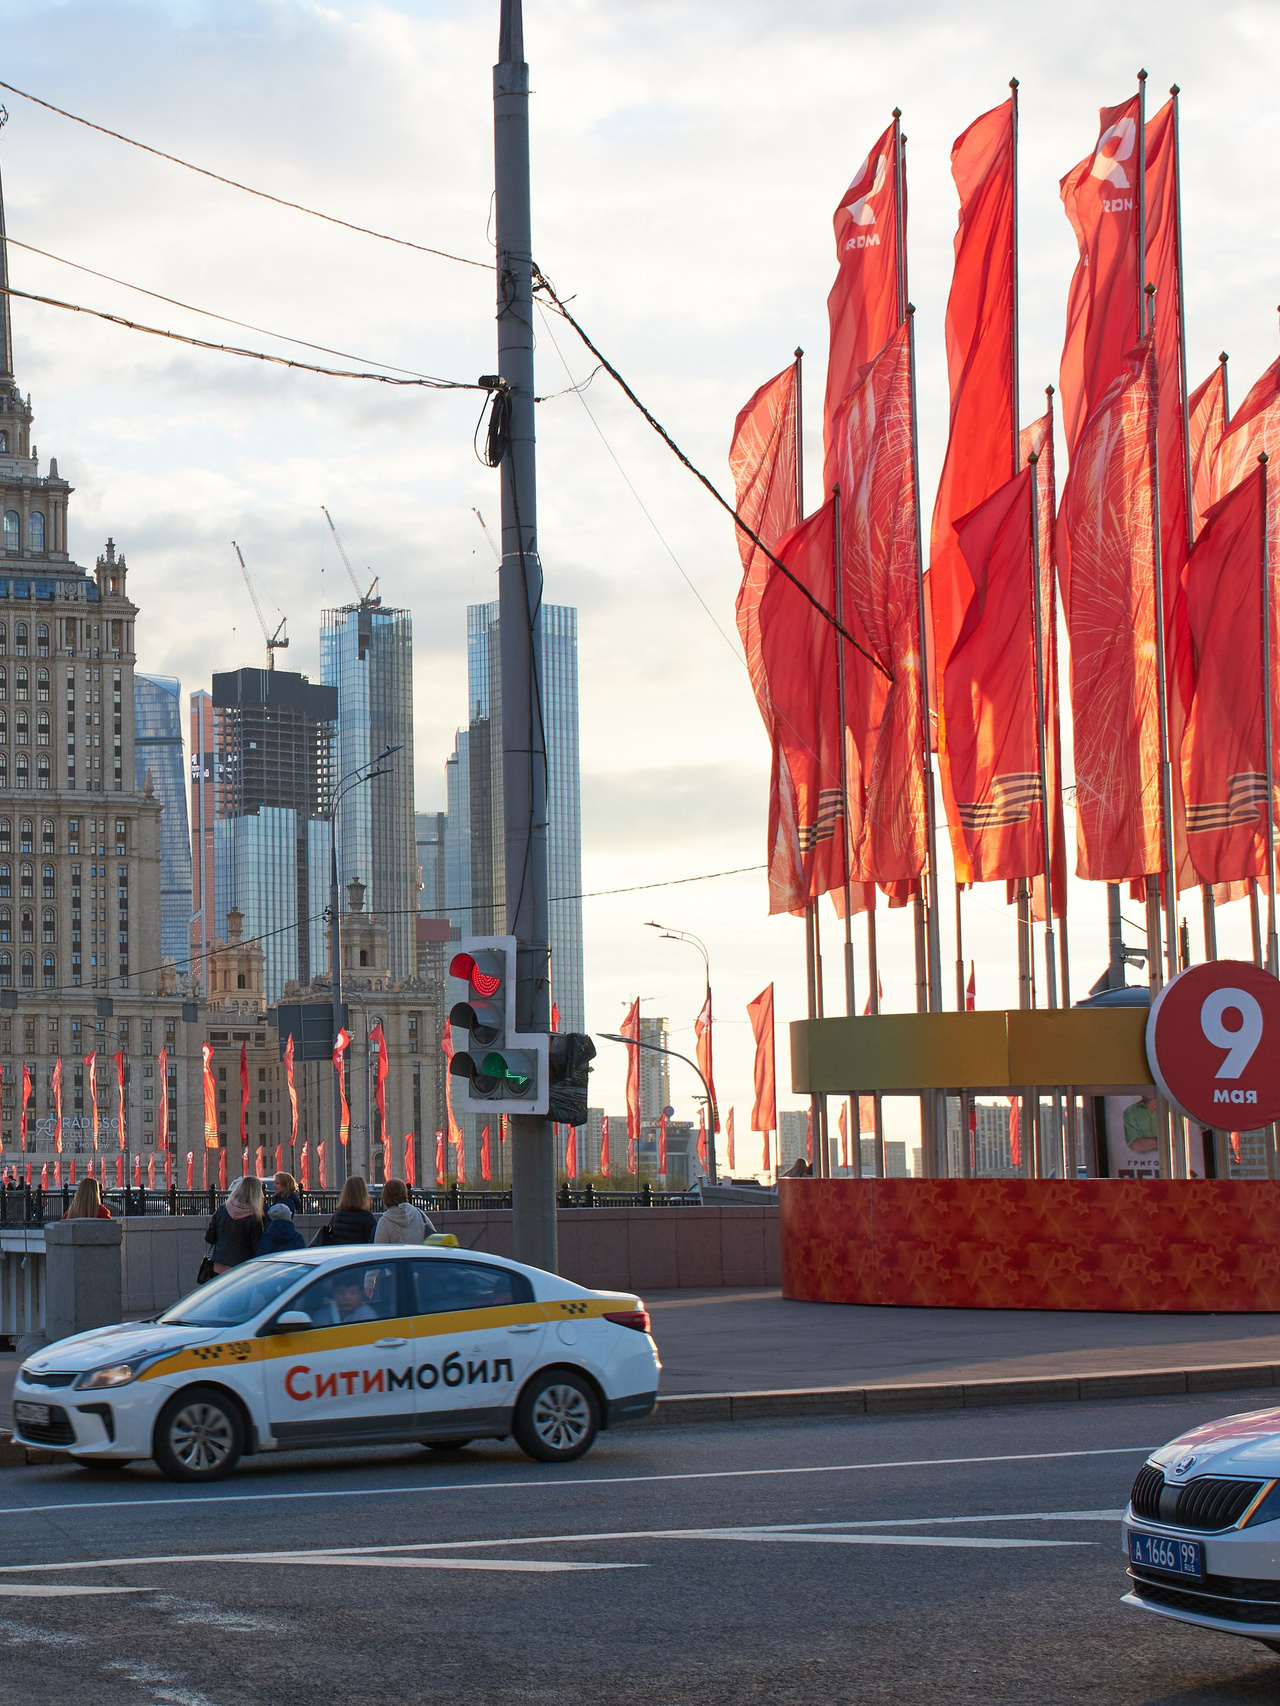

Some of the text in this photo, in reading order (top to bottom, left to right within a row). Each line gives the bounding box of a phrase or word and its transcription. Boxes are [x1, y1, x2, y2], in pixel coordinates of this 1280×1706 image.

[846, 233, 881, 251] RDM
[1200, 987, 1264, 1079] 9
[1213, 1089, 1258, 1104] мая
[62, 1117, 127, 1129] RADISSO
[284, 1351, 514, 1401] Ситимобил
[1145, 1538, 1175, 1567] 1666
[1181, 1543, 1195, 1565] 99
[1183, 1563, 1195, 1573] RUS
